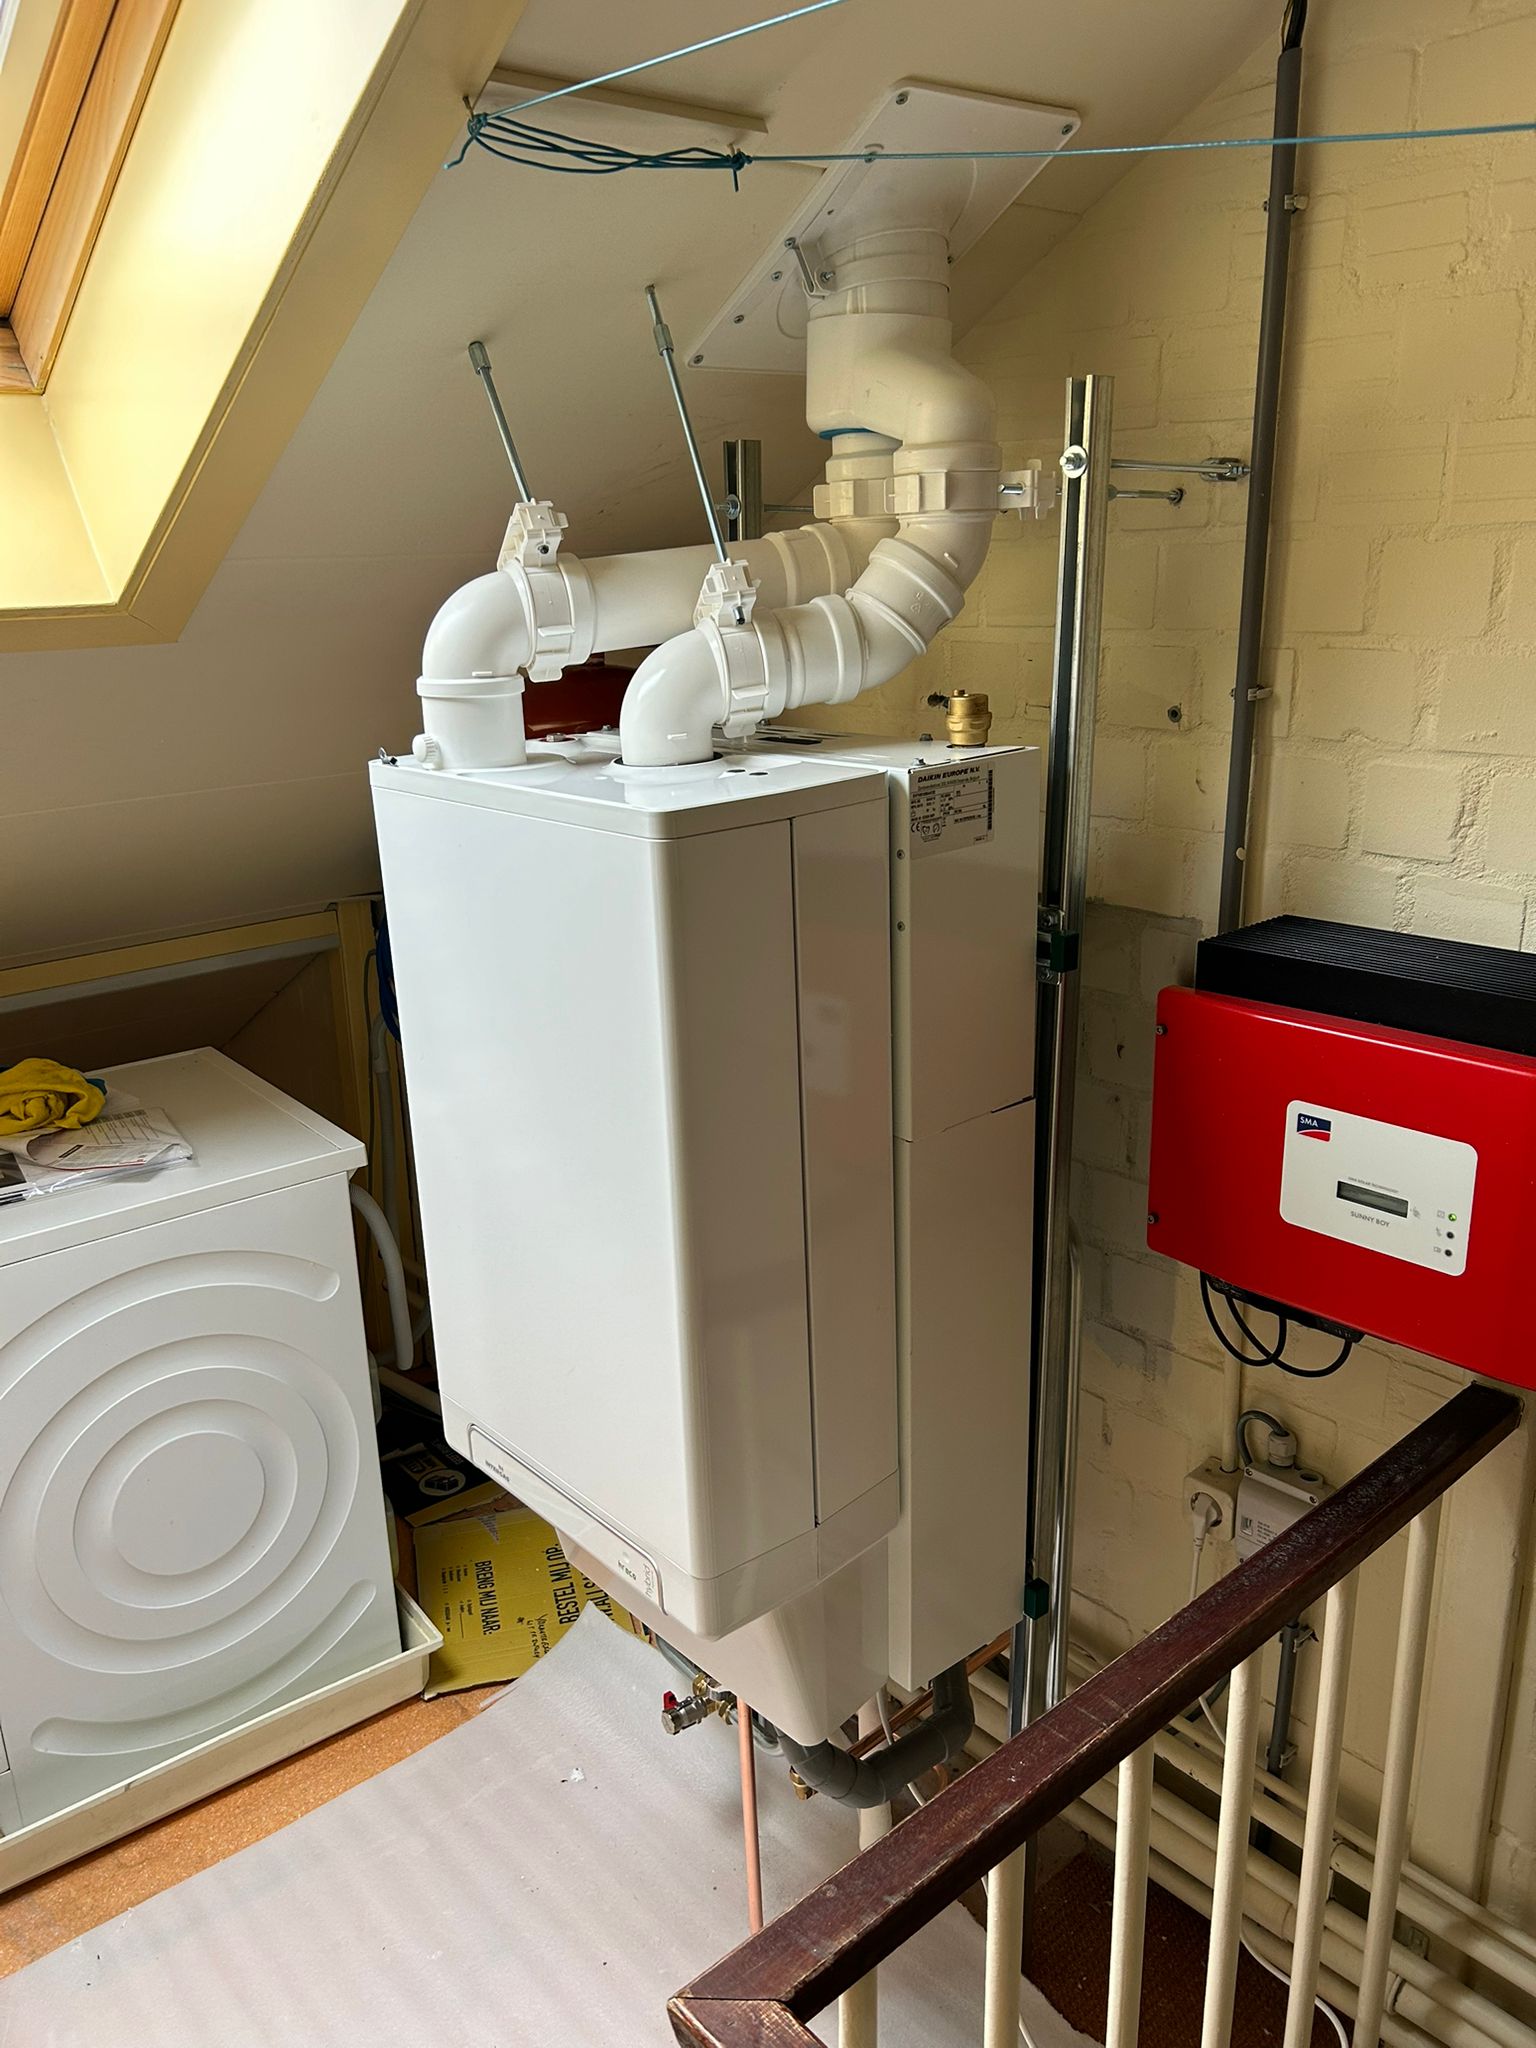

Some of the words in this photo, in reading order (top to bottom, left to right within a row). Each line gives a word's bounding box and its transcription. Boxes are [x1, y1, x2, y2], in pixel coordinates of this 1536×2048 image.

[918, 773, 941, 783] DAIKIN
[942, 768, 969, 778] EUROPE
[1299, 1116, 1319, 1128] SMA
[1350, 1210, 1375, 1223] SUNNY
[1375, 1218, 1390, 1227] BOY
[474, 1560, 494, 1590] BRENG
[548, 1562, 572, 1582] MIJ
[478, 1589, 497, 1608] MIJ
[553, 1582, 580, 1624] BESTEL
[480, 1607, 502, 1636] NAAR:
